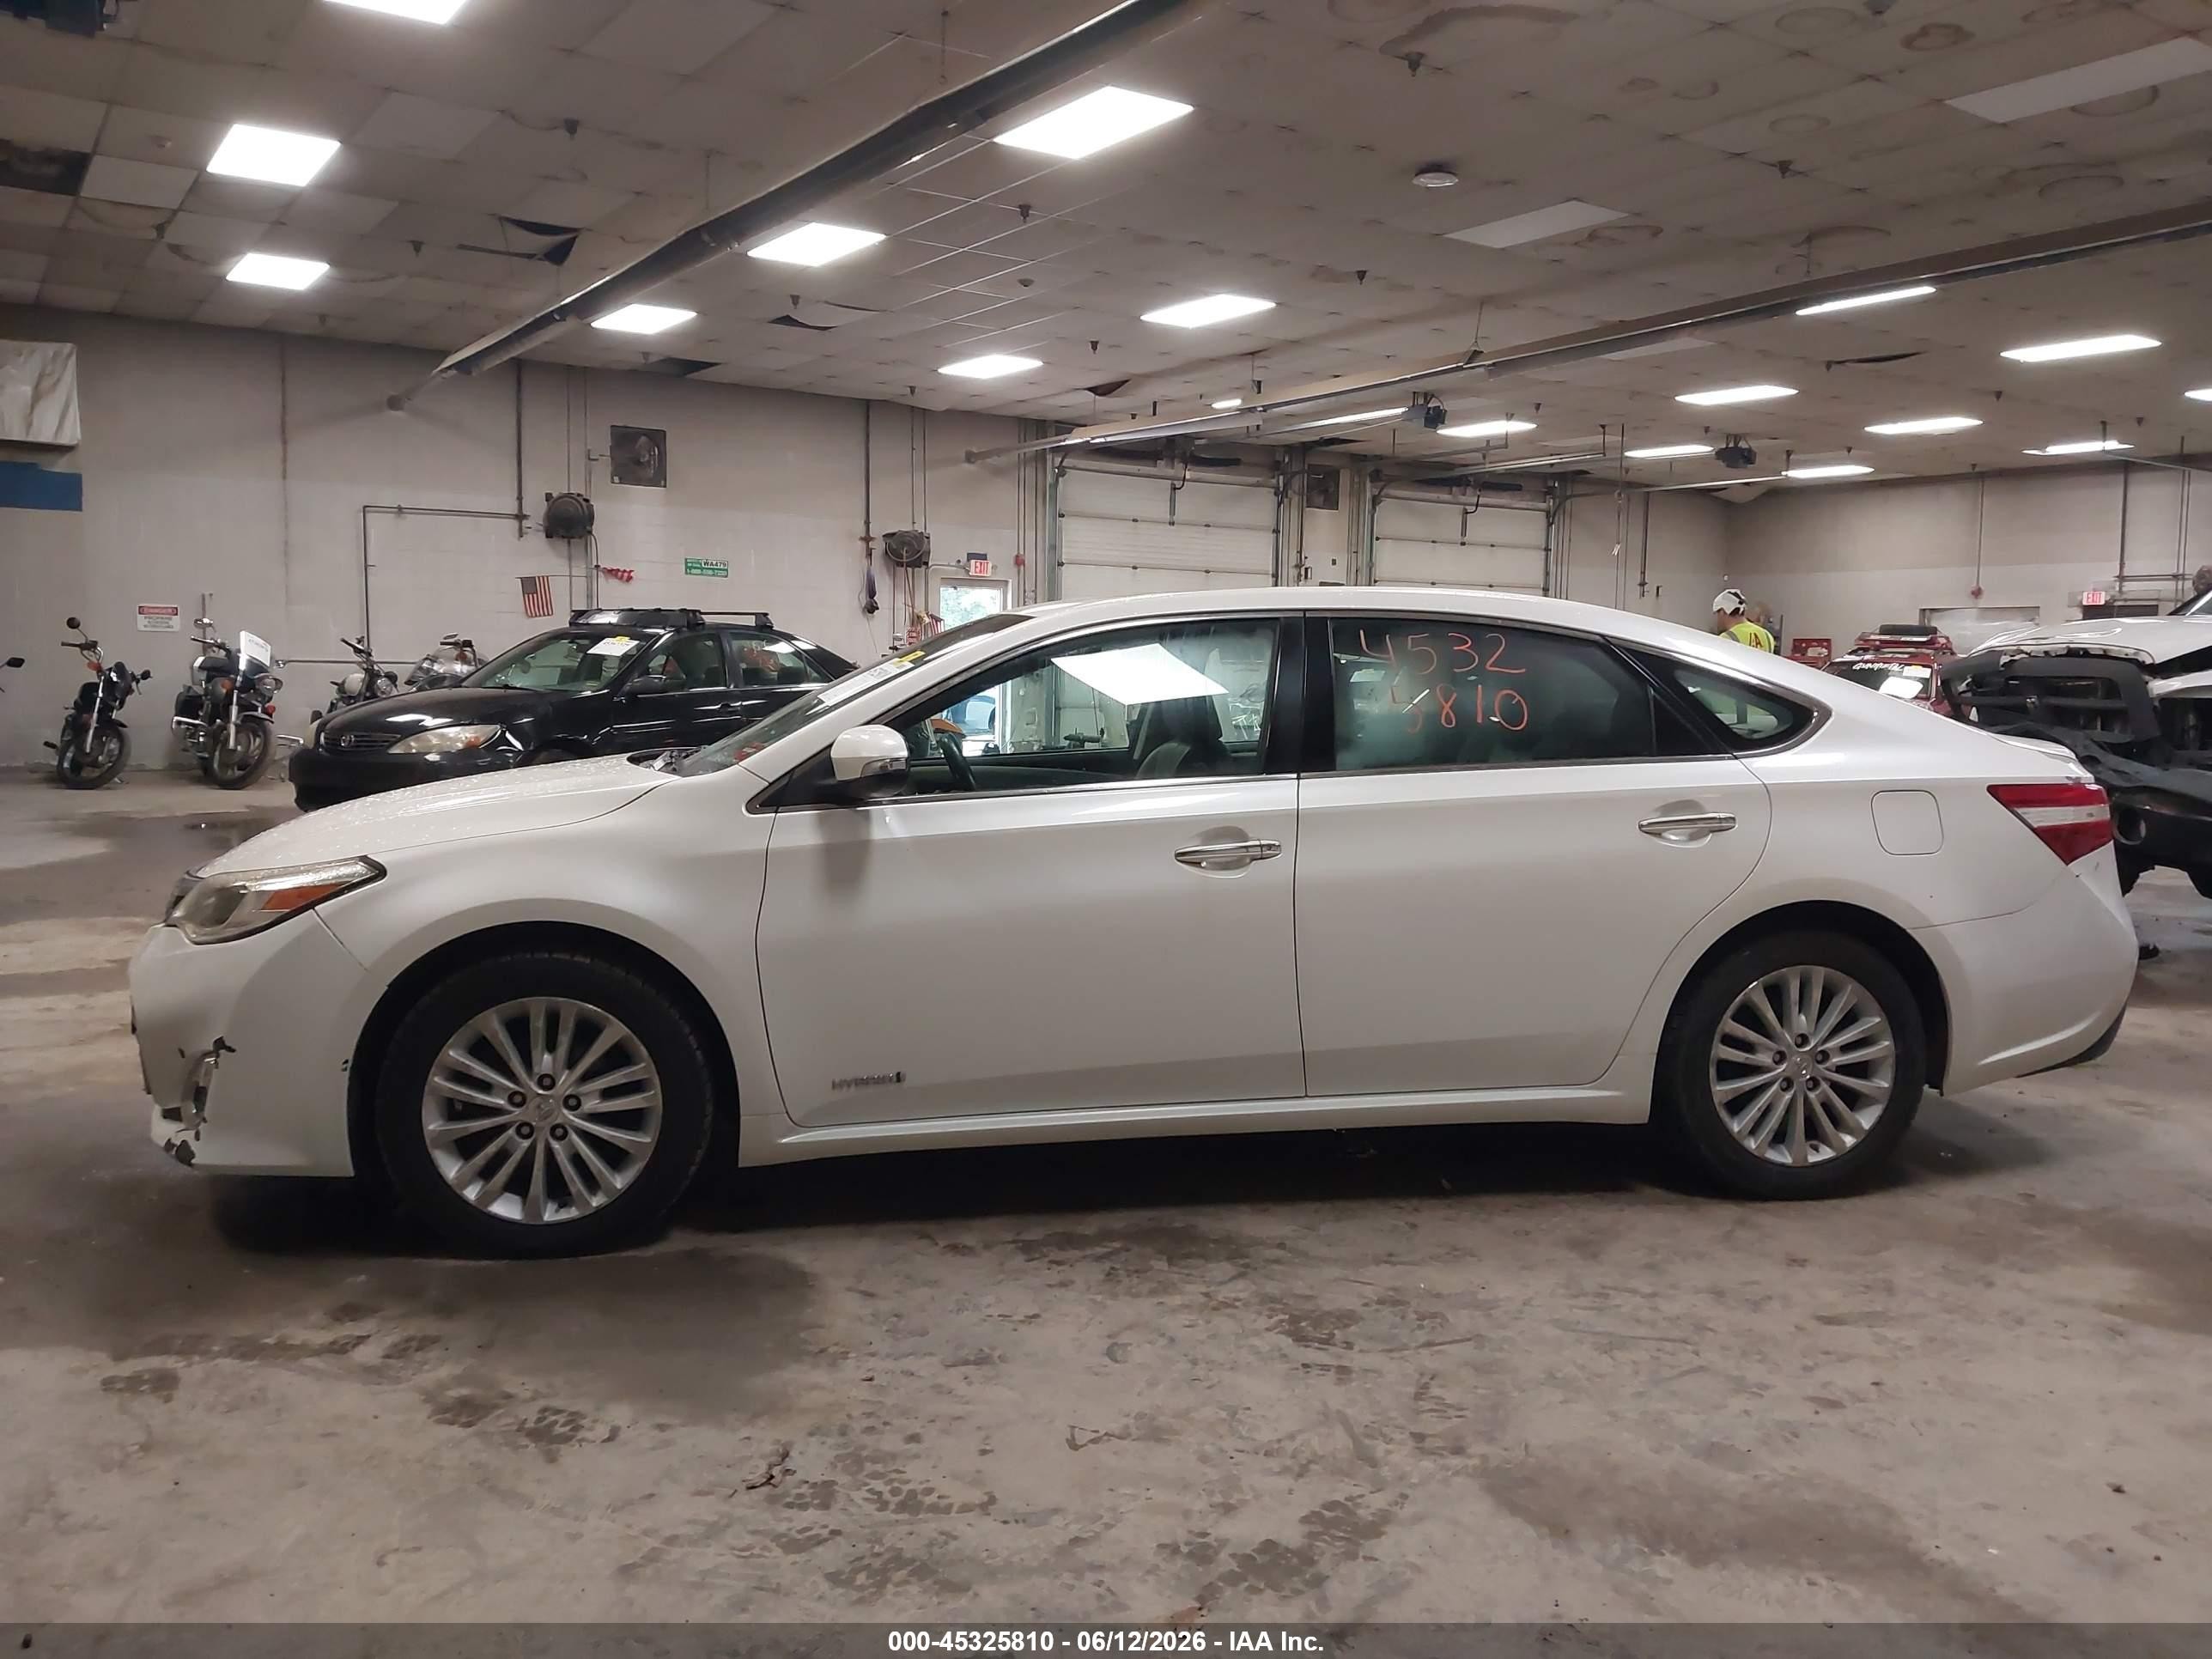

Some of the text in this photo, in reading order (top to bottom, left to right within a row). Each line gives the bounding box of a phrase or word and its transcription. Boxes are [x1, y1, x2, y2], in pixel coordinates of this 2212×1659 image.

[703, 559, 726, 568] WA479
[975, 561, 990, 574] EXIT
[2086, 592, 2102, 604] EXIT
[1359, 629, 1527, 675] 4532
[1389, 683, 1528, 733] 5810
